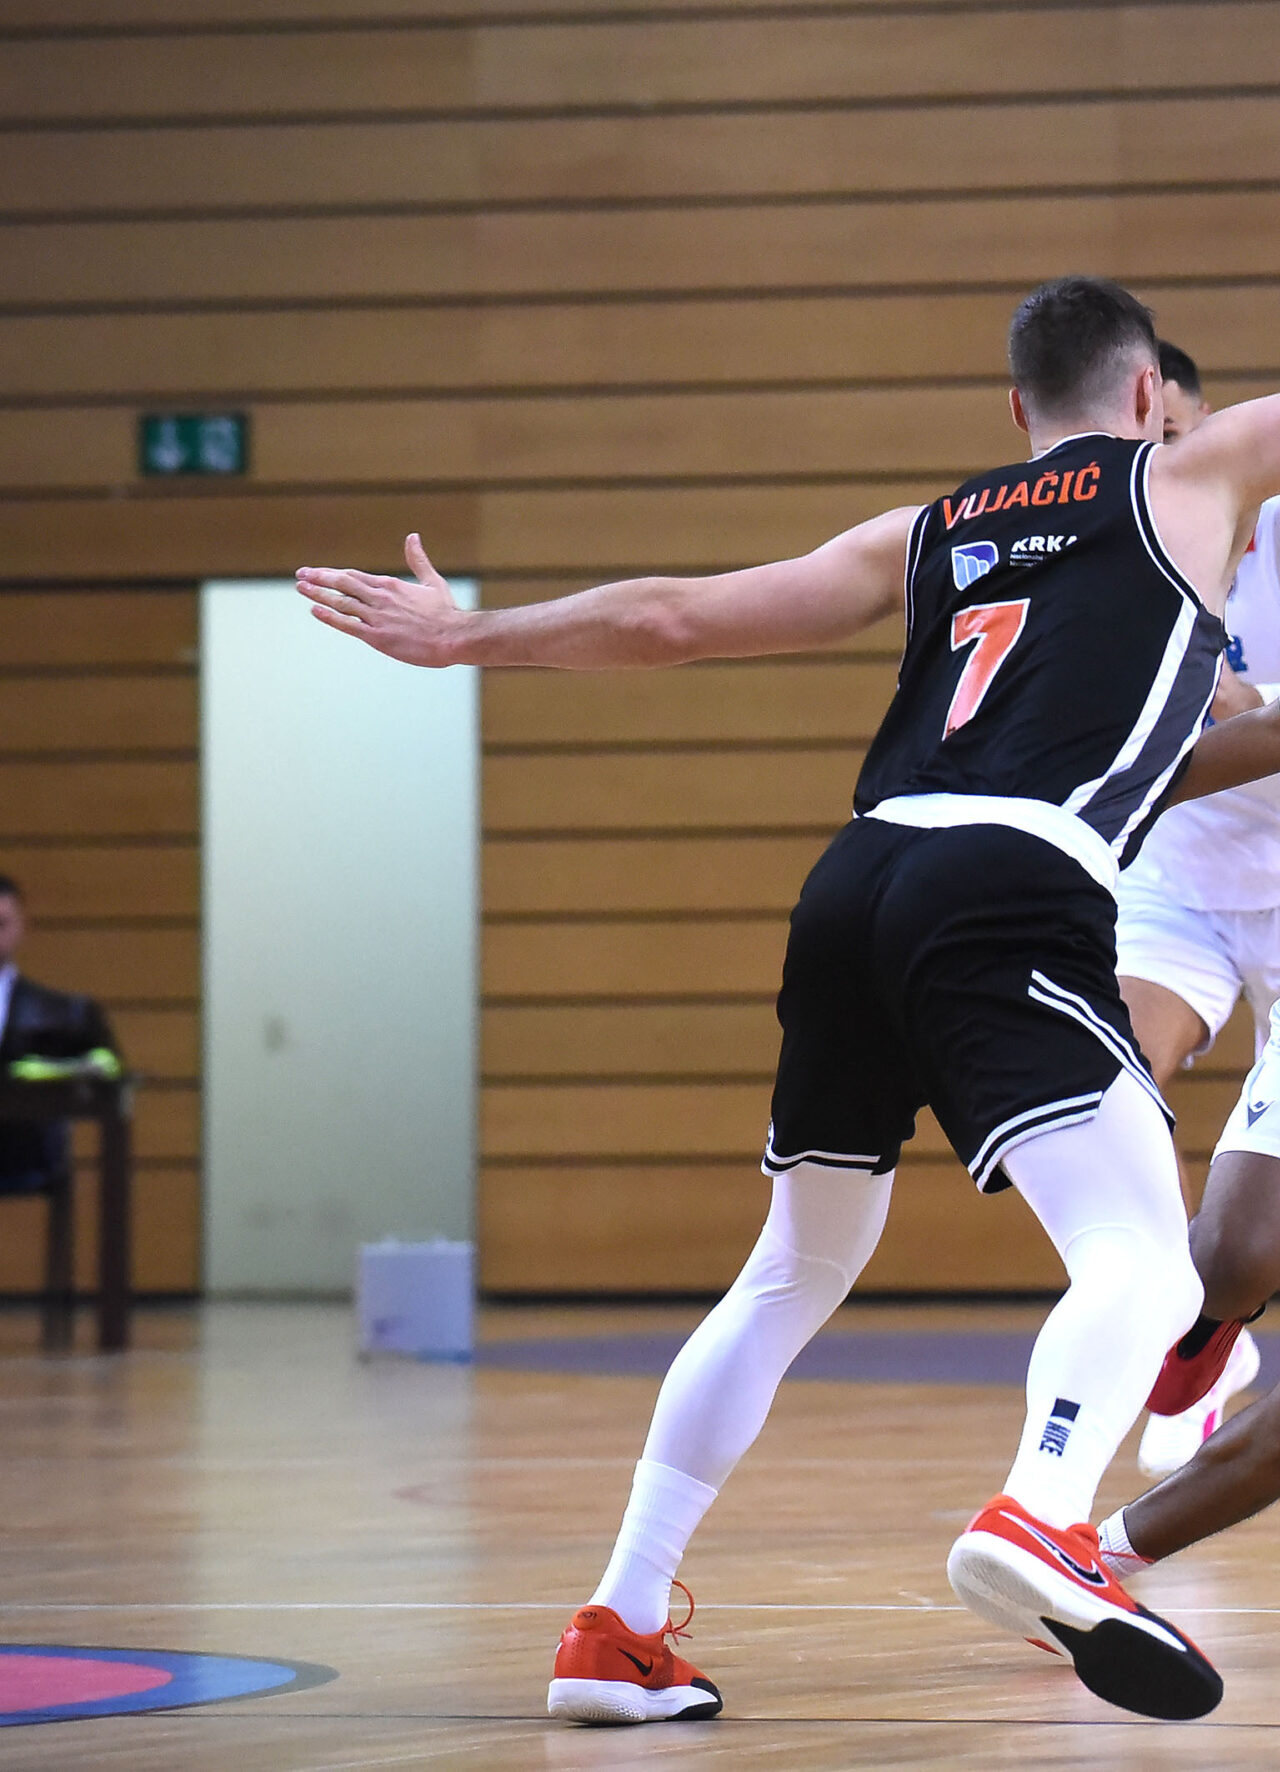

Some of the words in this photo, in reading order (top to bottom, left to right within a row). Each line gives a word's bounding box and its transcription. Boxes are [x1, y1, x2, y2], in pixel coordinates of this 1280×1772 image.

[943, 461, 1101, 530] VUJAČIĆ
[941, 598, 1031, 742] 7
[1039, 1420, 1072, 1457] NIKE
